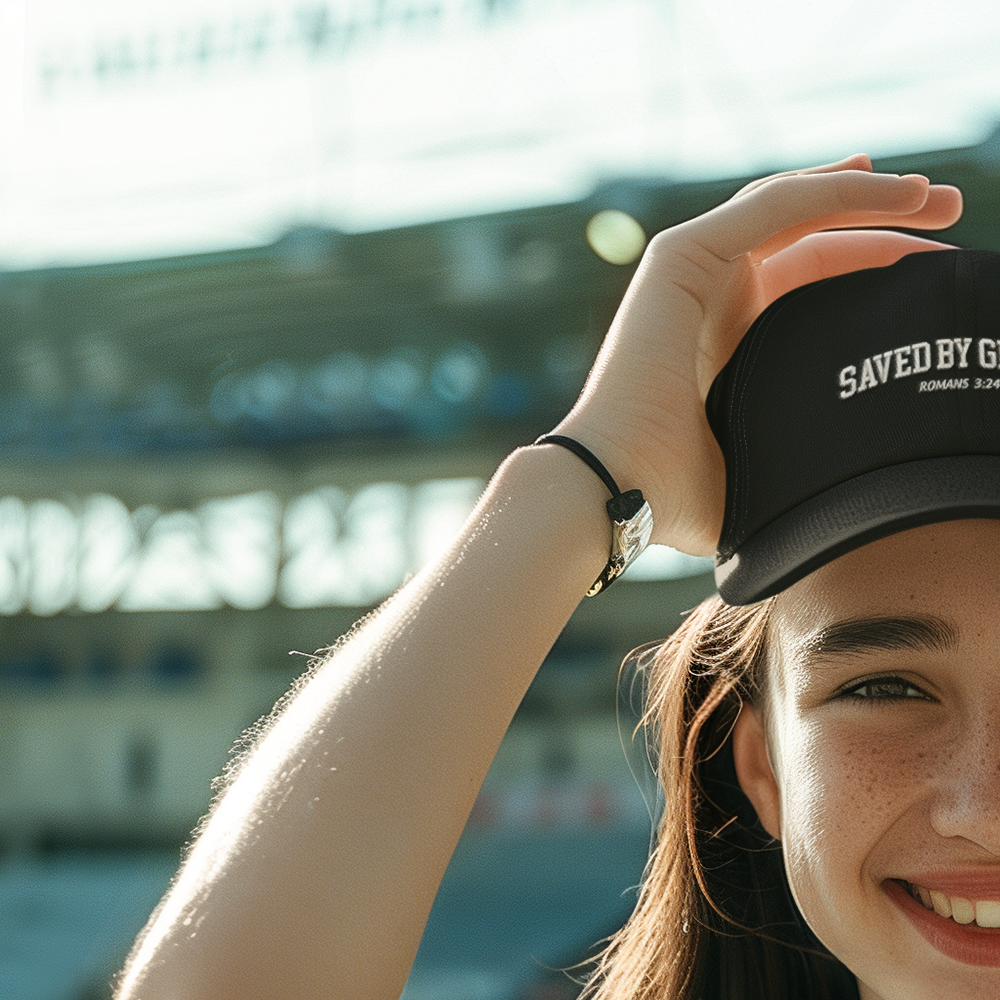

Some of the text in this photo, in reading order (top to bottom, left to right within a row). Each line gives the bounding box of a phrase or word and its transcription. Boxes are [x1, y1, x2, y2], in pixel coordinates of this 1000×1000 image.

[838, 341, 932, 400] SAVED
[935, 337, 973, 370] BY
[918, 377, 1000, 393] ROMANS 3:24
